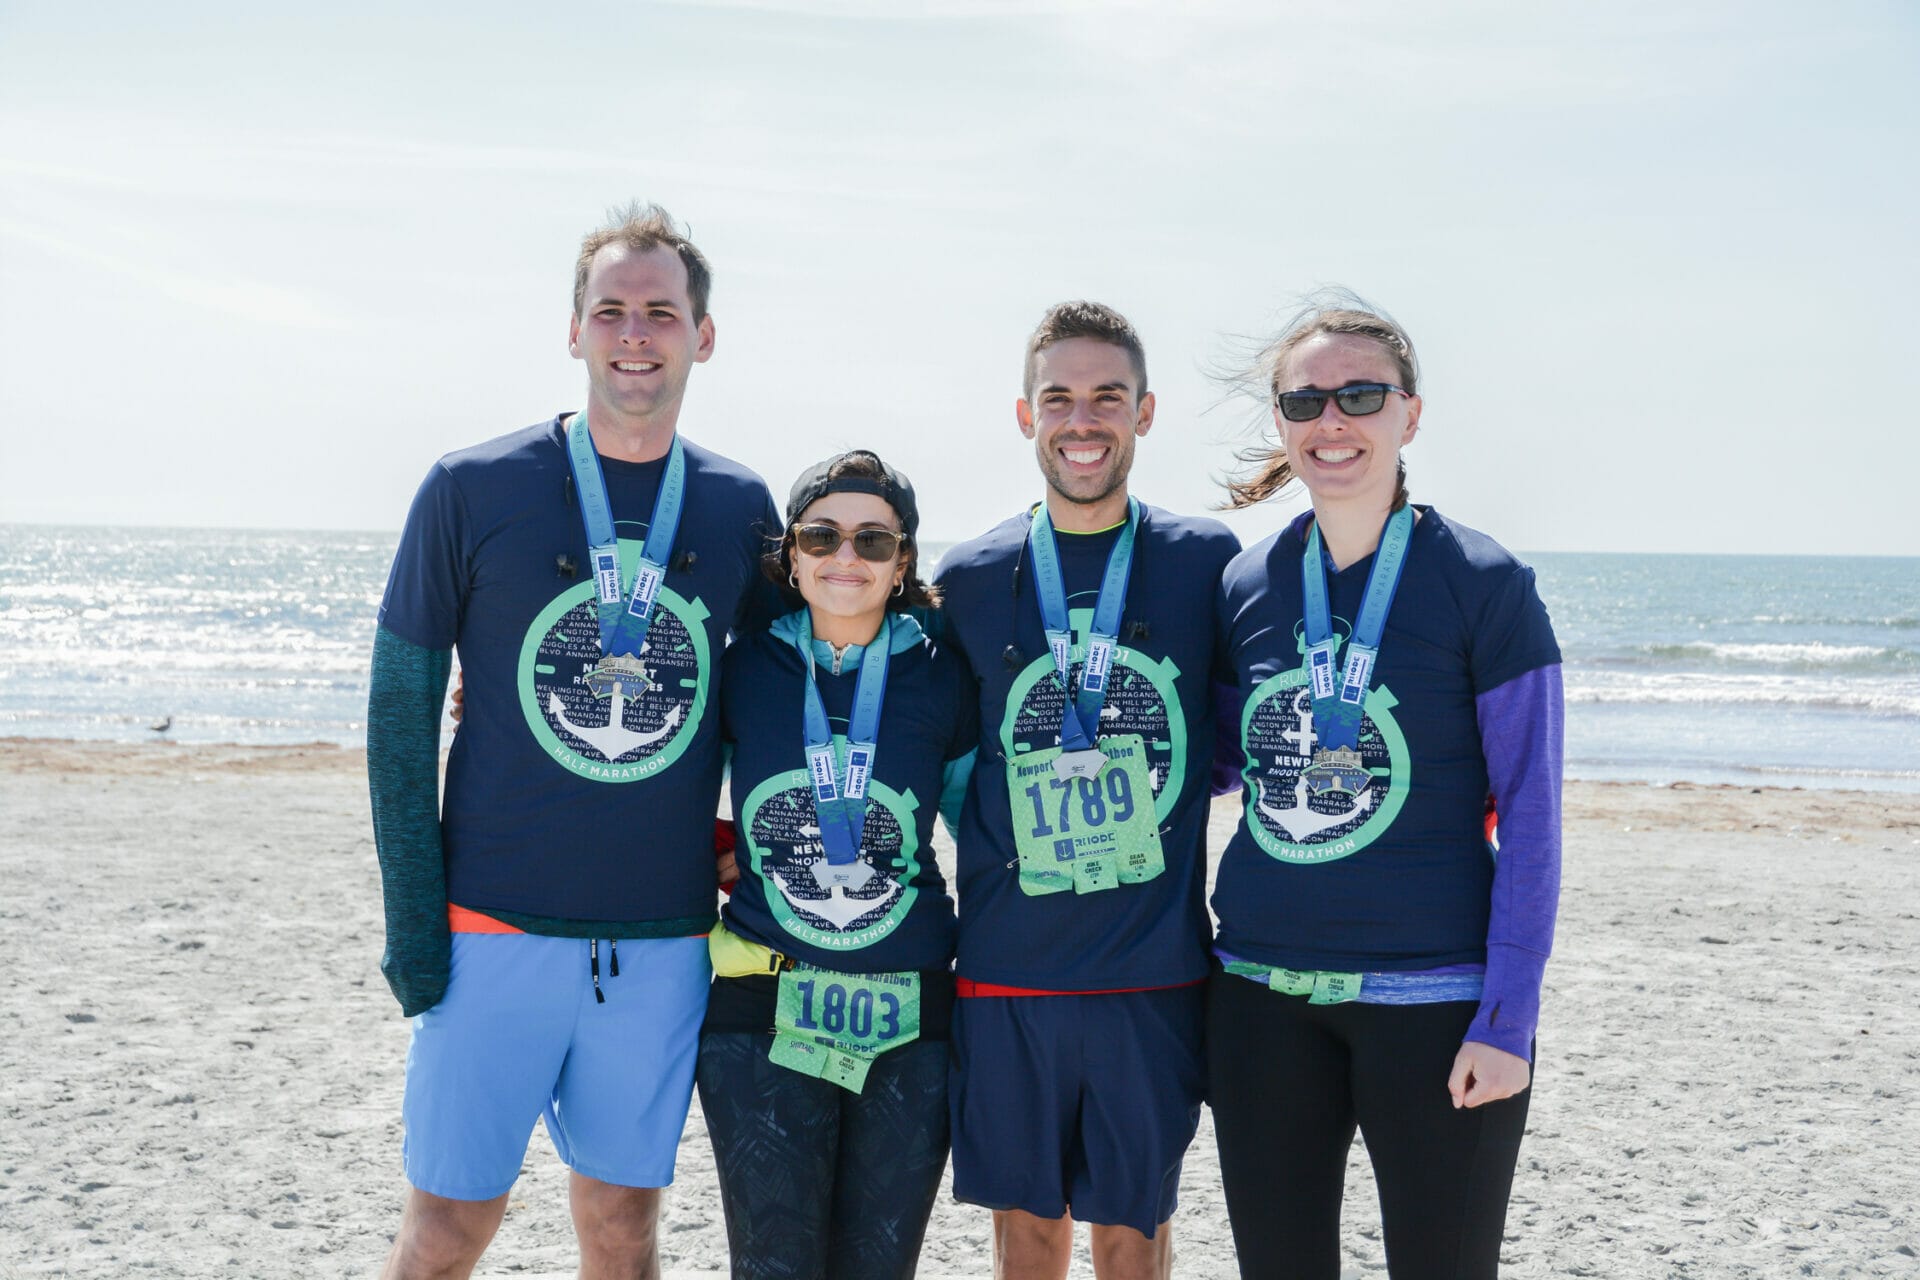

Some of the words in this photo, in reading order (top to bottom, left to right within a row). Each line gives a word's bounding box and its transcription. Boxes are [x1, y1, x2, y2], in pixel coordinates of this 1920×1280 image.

[1375, 534, 1401, 600] MARATHON
[568, 621, 600, 629] ANNAN
[566, 650, 600, 659] ANNAND
[1036, 693, 1065, 701] ANNAN
[554, 747, 588, 770] HALF
[589, 755, 667, 778] MARATHON
[1275, 754, 1311, 768] NEWP
[1267, 767, 1300, 777] RHODE
[1025, 767, 1135, 839] 1789
[768, 809, 817, 820] ANNANDAL
[1256, 829, 1280, 852] HALF
[1280, 838, 1356, 860] MARATHON
[1085, 866, 1102, 874] CHECK
[785, 918, 818, 940] HALF
[820, 917, 895, 946] MARATHON
[795, 979, 900, 1040] 1803
